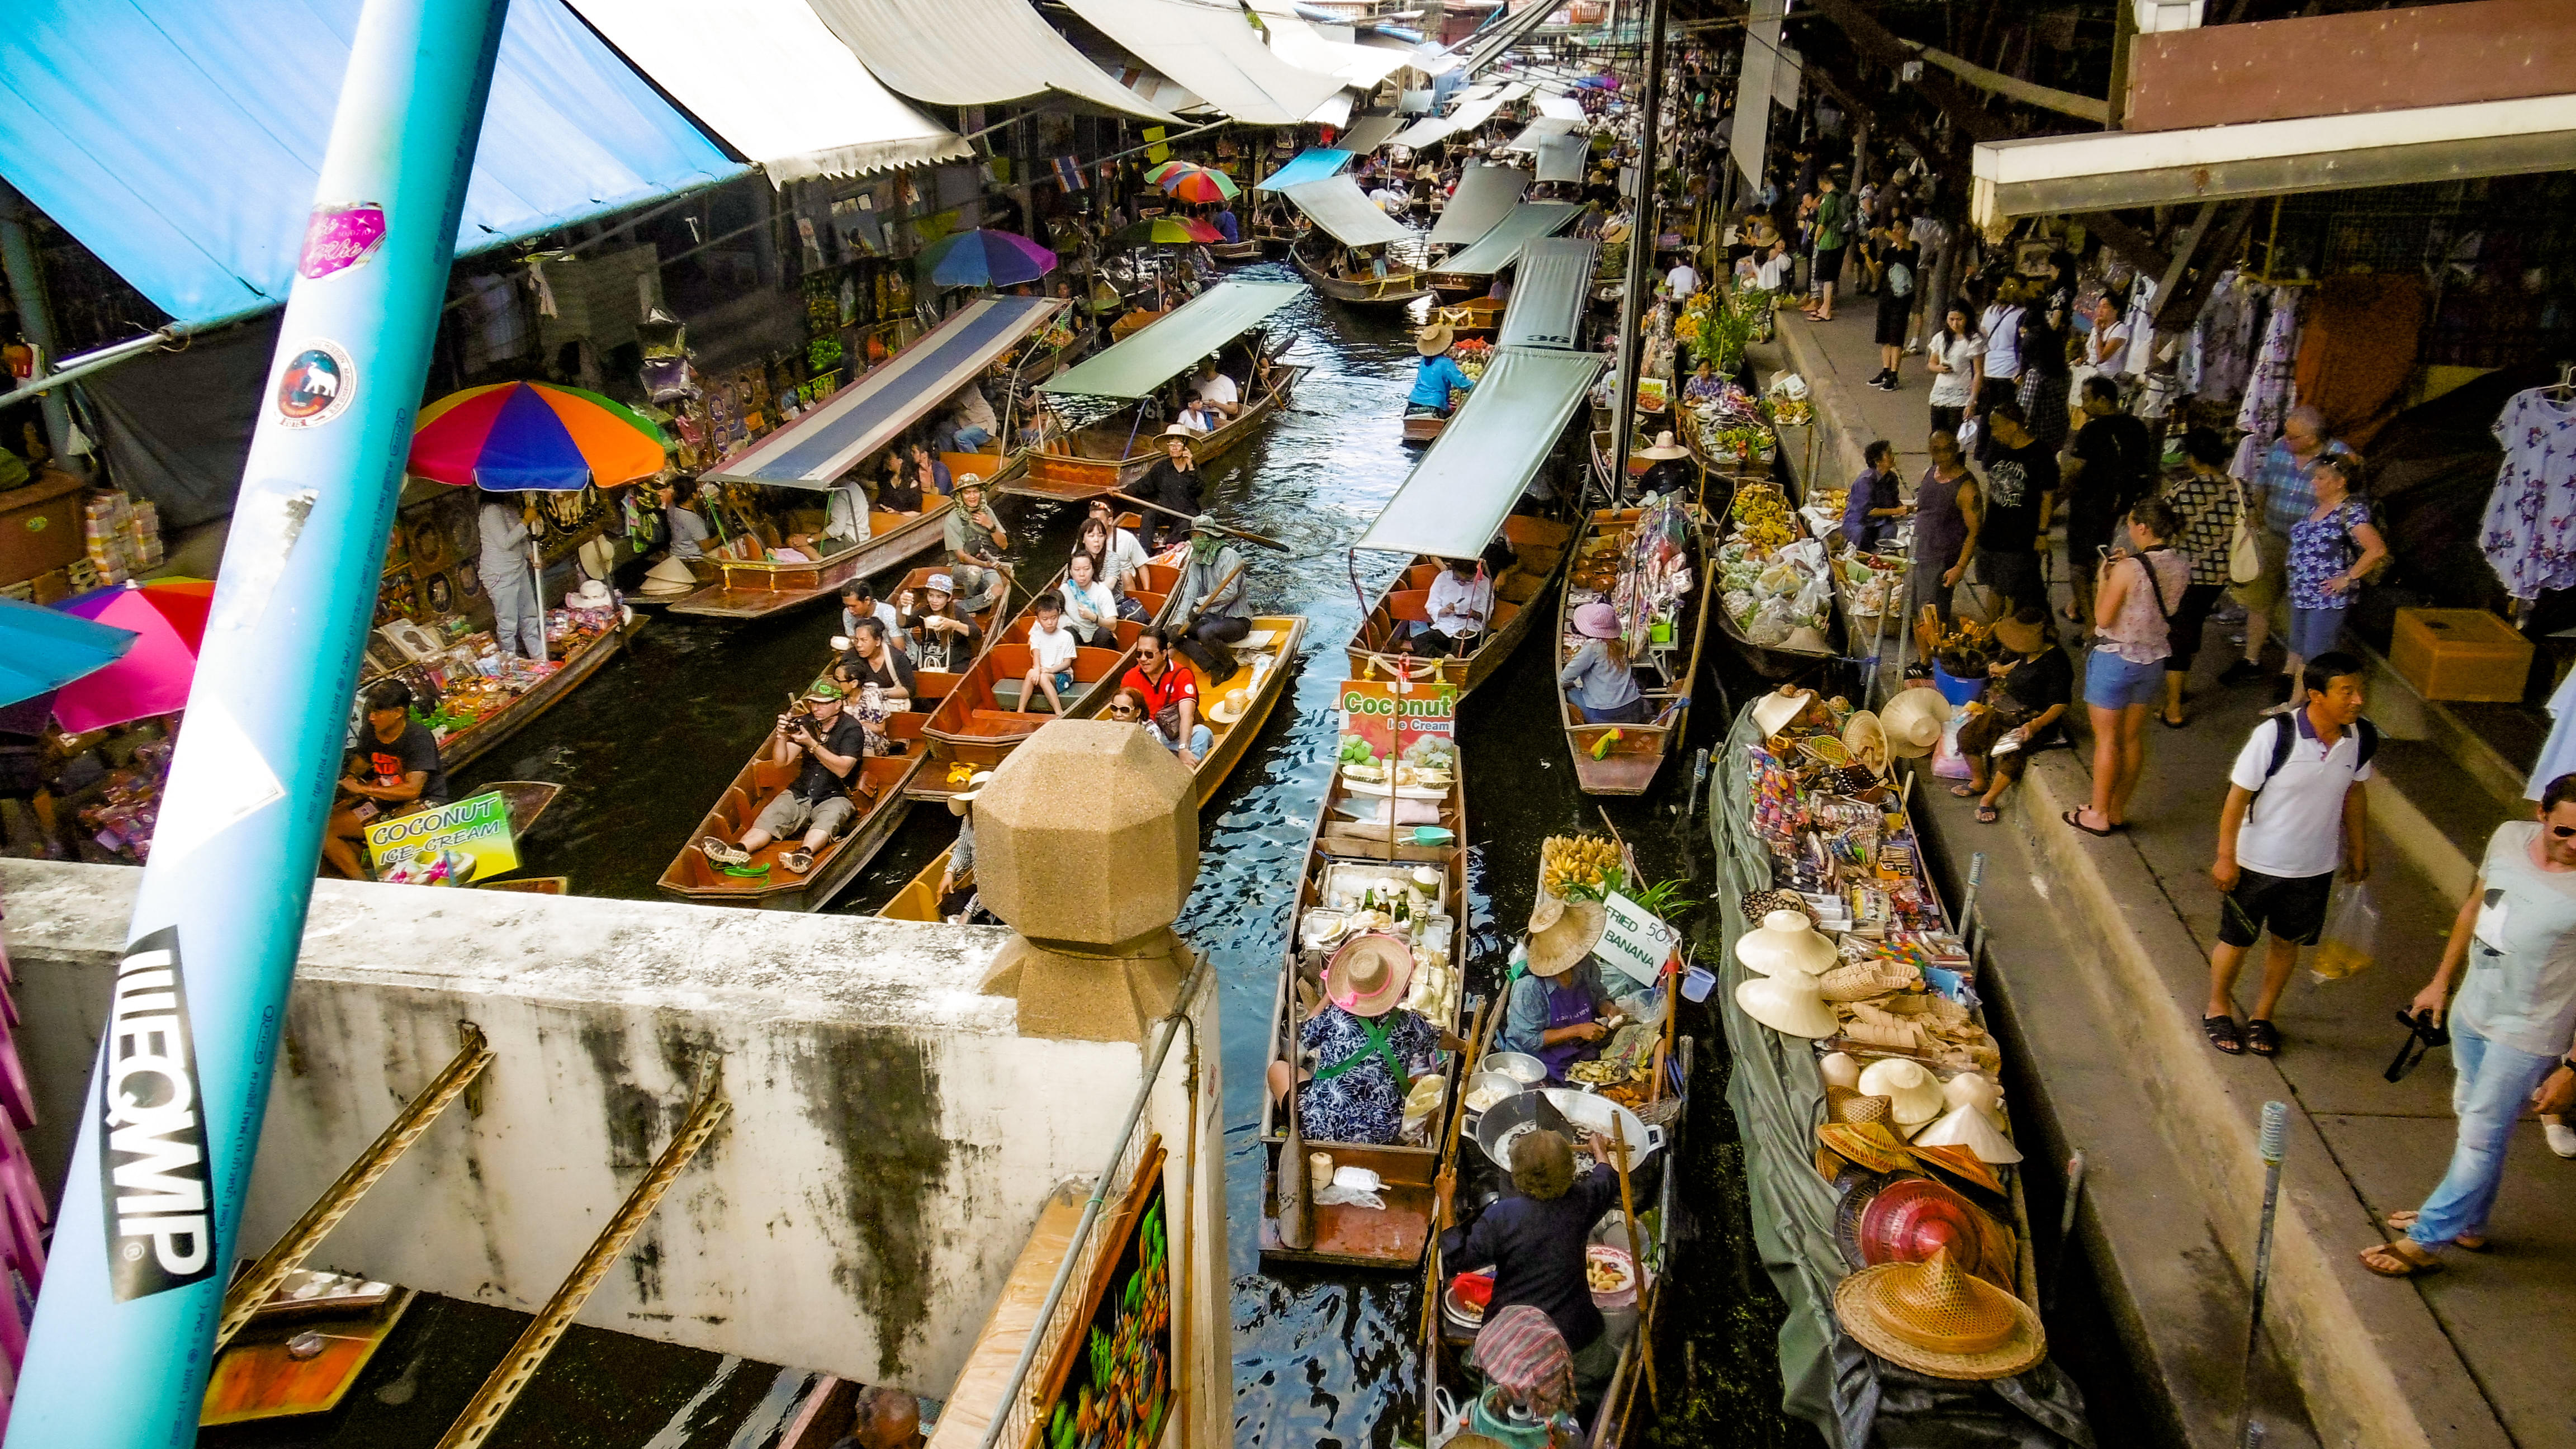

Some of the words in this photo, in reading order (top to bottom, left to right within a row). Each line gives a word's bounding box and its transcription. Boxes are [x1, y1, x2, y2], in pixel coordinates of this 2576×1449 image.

[1527, 335, 1570, 343] 36
[1343, 691, 1452, 717] Coconut
[1388, 718, 1407, 730] Ie
[1411, 719, 1449, 731] Cream
[373, 797, 497, 845] COCONUT
[380, 821, 499, 865] ICE-CREAM
[1606, 905, 1638, 932] FRIED
[1604, 930, 1654, 968] BANANA
